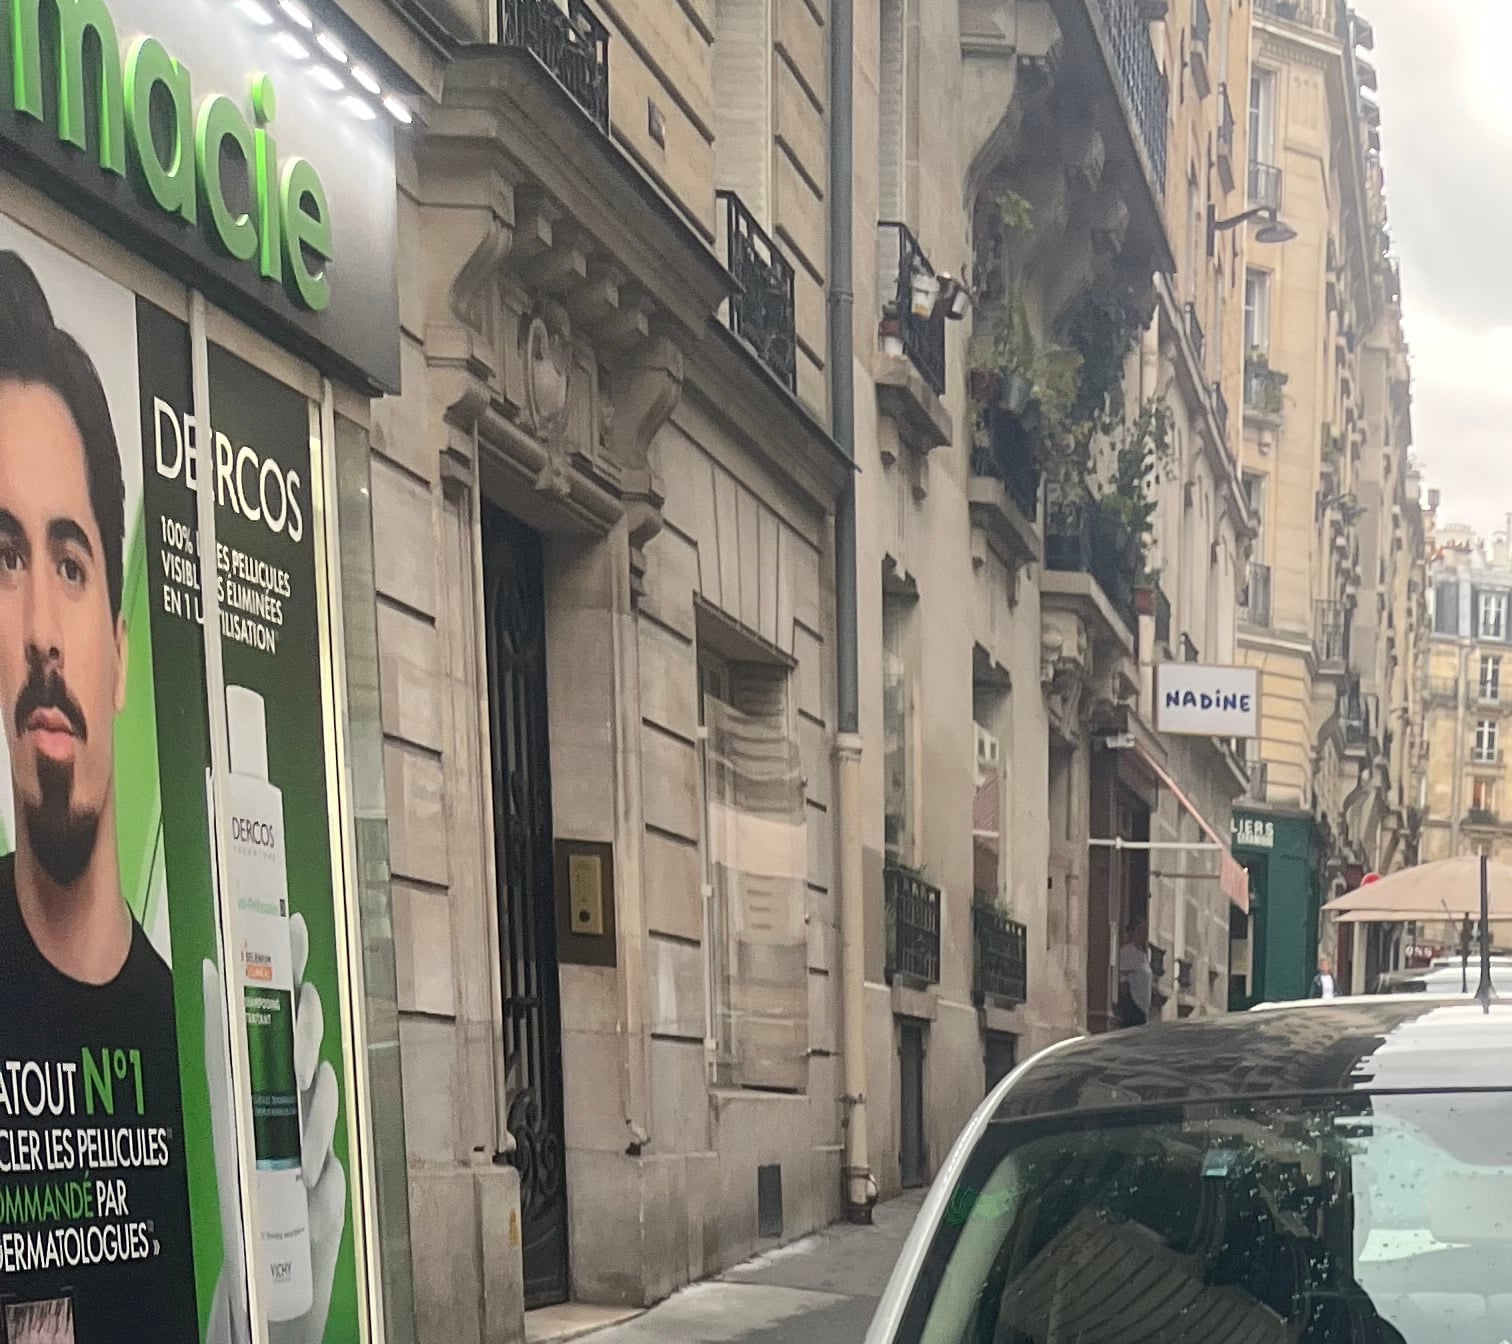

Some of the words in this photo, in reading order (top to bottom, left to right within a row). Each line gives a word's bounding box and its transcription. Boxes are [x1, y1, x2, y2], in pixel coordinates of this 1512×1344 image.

[11, 0, 332, 312] macie
[160, 515, 194, 554] 100%
[231, 552, 291, 598] PELLICULES
[160, 549, 226, 603] VISIBLS
[227, 572, 283, 625] ÉLIMINÉES
[163, 584, 182, 618] EN
[184, 592, 191, 620] 1
[232, 816, 275, 849] DERCOS
[45, 1128, 75, 1170] LES
[77, 1127, 169, 1168] PELLICULES
[96, 1178, 129, 1217] PAR
[0, 1221, 149, 1272] ERMATOLOGUES
